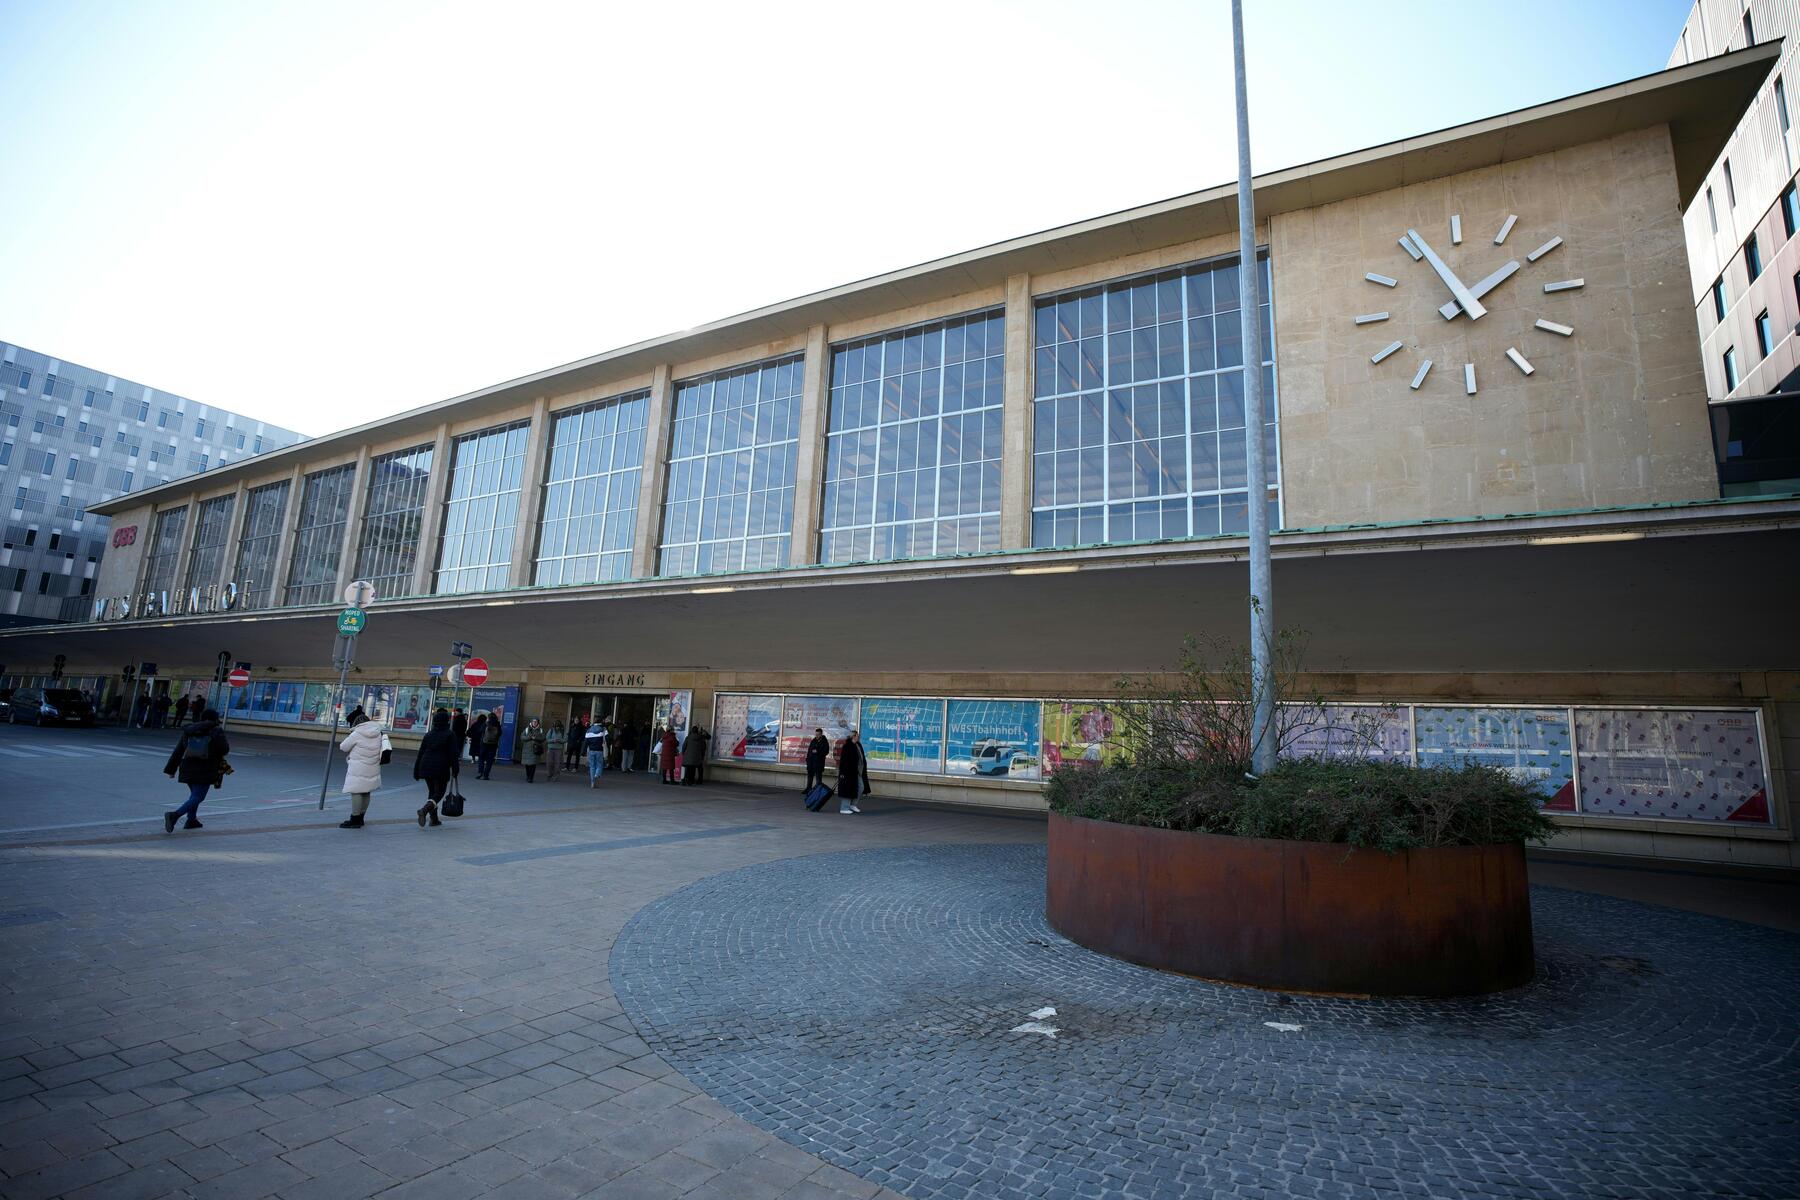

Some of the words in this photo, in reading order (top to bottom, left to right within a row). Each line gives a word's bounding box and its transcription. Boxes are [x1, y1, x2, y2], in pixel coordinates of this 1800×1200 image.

[344, 609, 361, 617] MOPED
[340, 624, 361, 632] SHARING
[585, 674, 645, 686] EINGANG
[926, 724, 941, 732] am
[951, 723, 1021, 735] WESTbahnhof!
